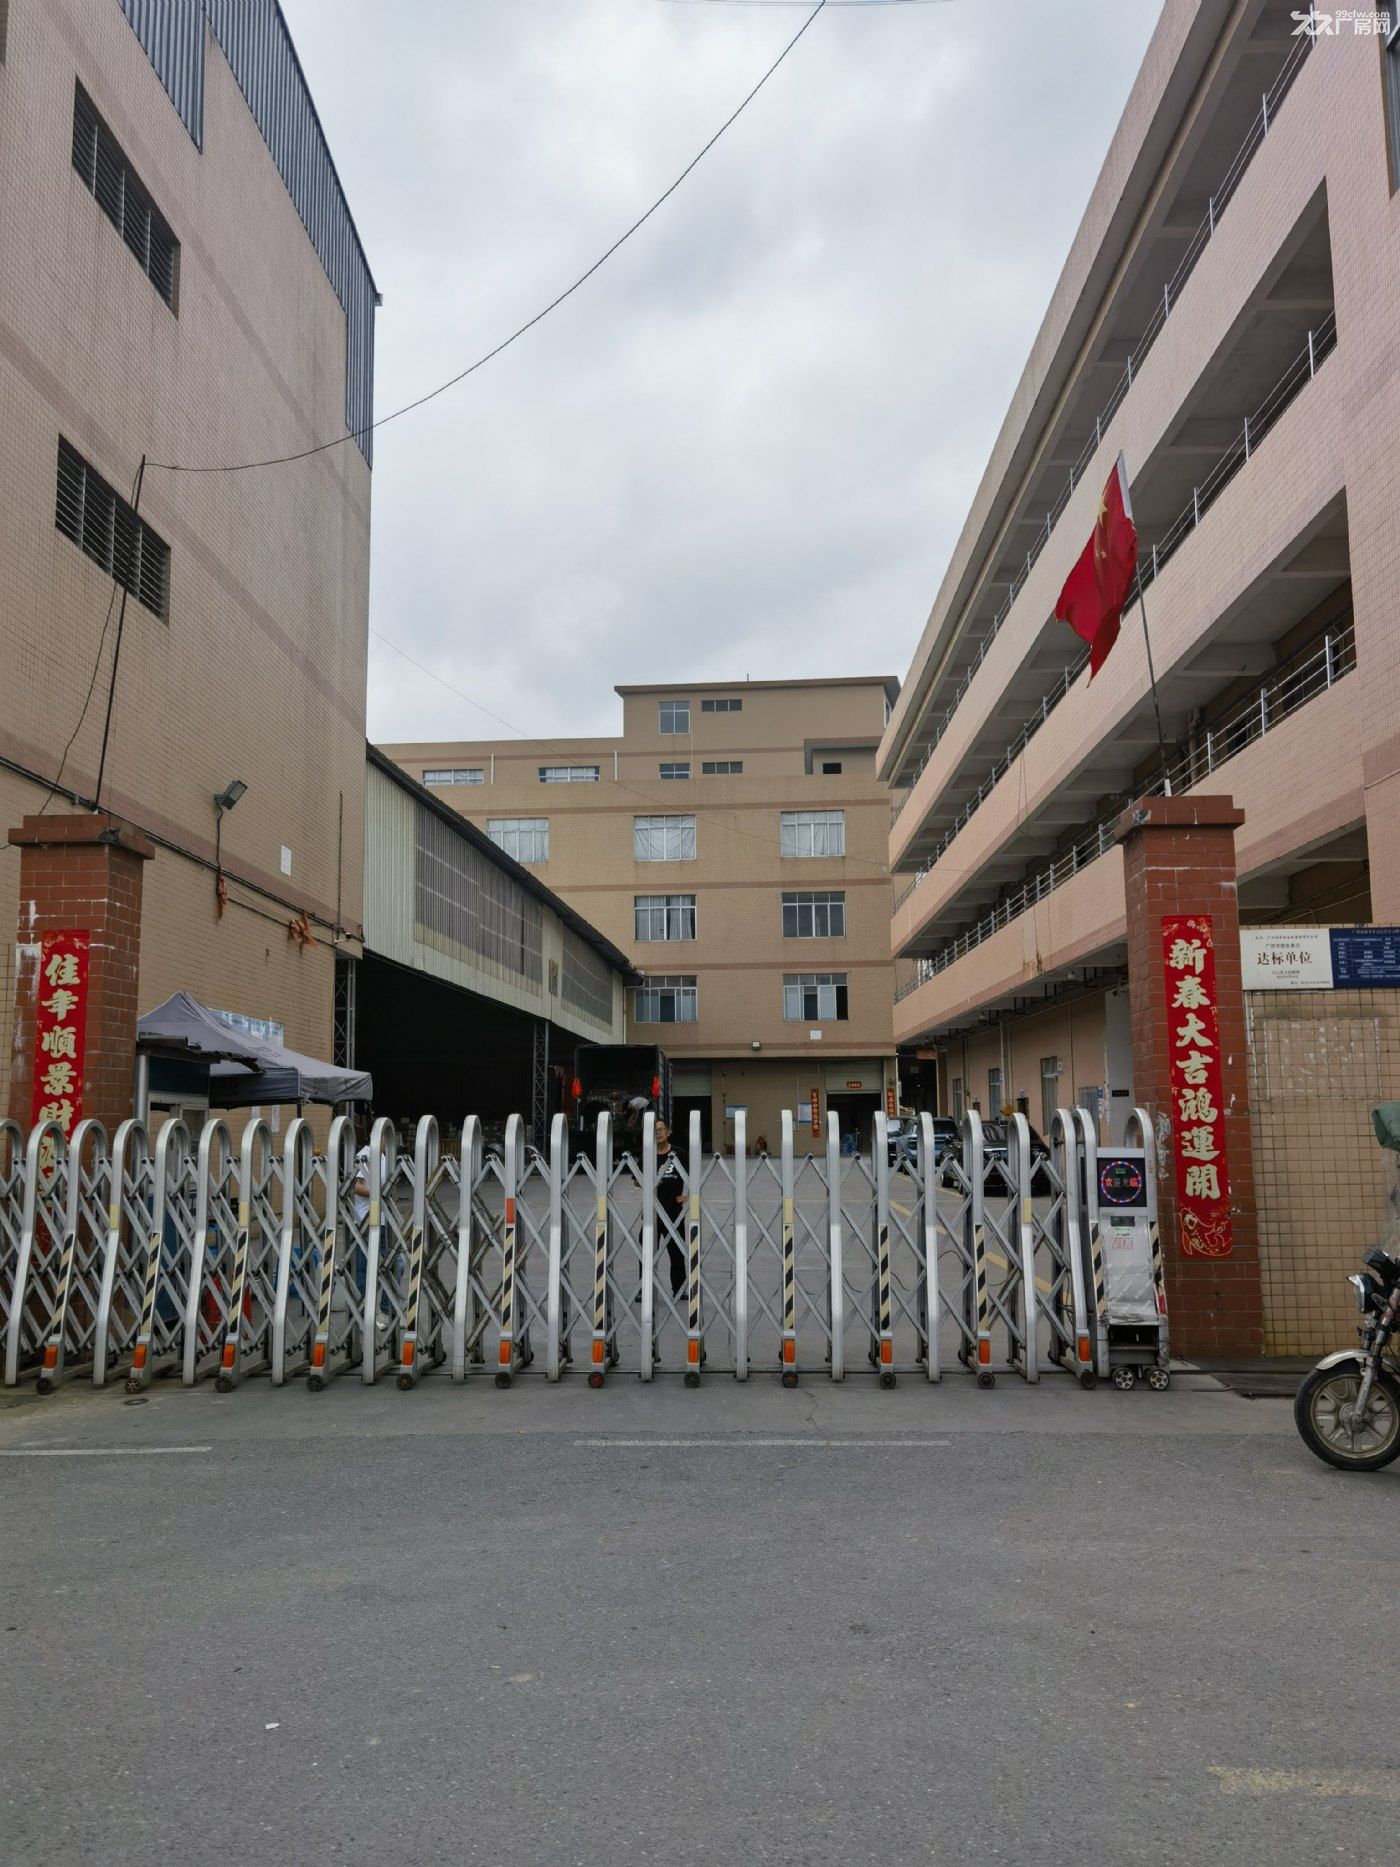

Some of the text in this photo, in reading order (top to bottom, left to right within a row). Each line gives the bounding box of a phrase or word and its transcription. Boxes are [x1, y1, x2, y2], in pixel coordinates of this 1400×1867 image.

[1257, 951, 1312, 966] 达标单位
[1168, 938, 1221, 1201] 新春大吉鴻運開
